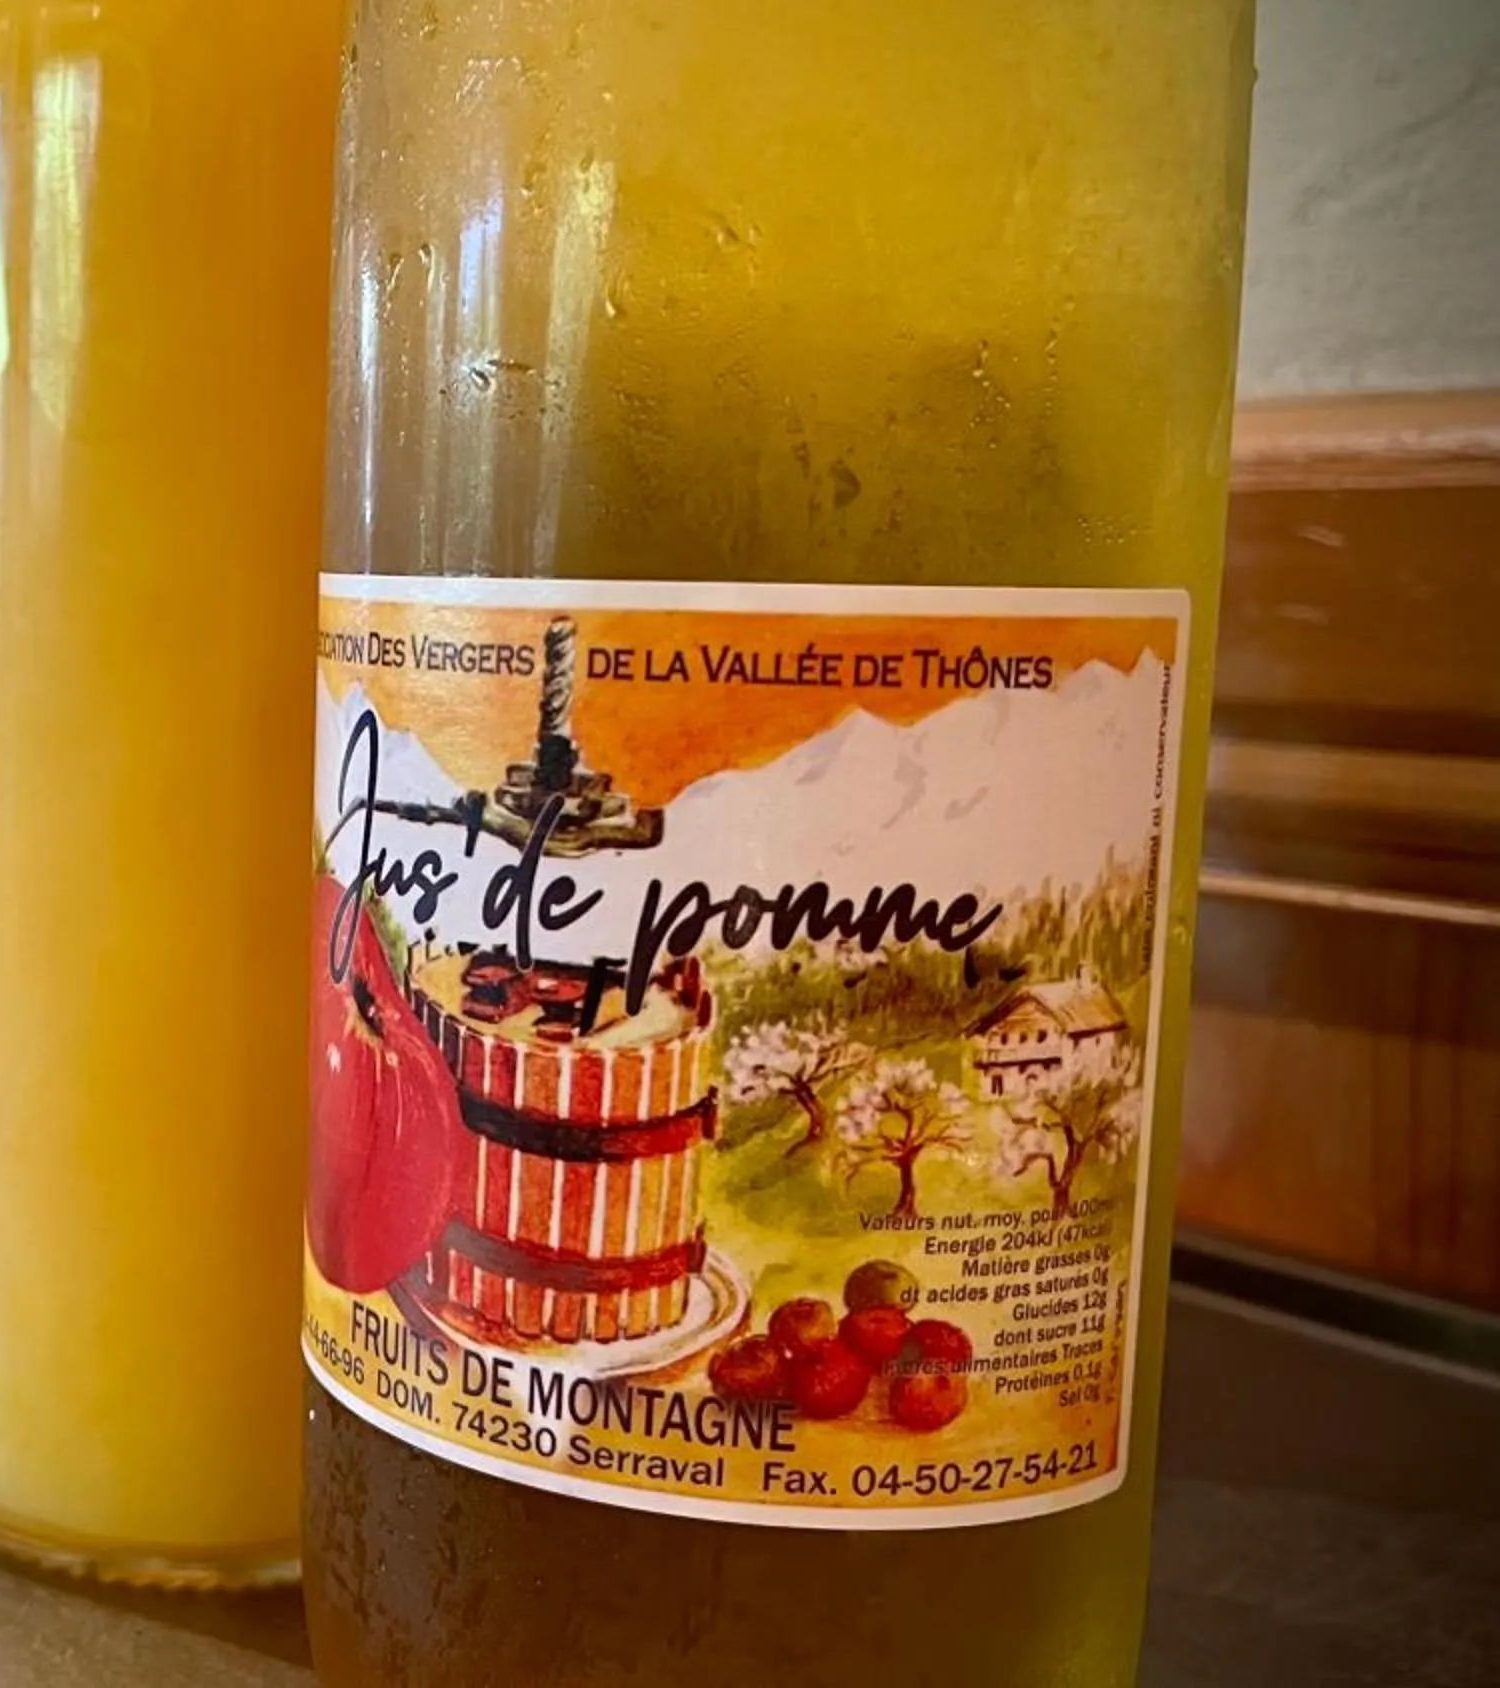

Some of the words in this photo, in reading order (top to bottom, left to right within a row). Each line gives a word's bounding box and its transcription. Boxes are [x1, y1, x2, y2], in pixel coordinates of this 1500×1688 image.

[410, 633, 536, 677] VERGERS
[587, 647, 635, 681] DE
[644, 649, 690, 683] LA
[699, 642, 842, 687] VALLÉE
[852, 654, 904, 688] DE
[912, 645, 1054, 690] THÔNES
[325, 709, 461, 985] Jus
[483, 794, 604, 973] de
[624, 877, 1004, 1017] pomme
[859, 1211, 935, 1231] Valeurs
[940, 1212, 978, 1230] nut.
[983, 1210, 1026, 1230] moy.
[924, 1235, 997, 1257] Energie
[961, 1254, 1031, 1277] Matière
[1035, 1251, 1092, 1275] grasses
[926, 1283, 989, 1303] acides
[992, 1281, 1031, 1304] gras
[1012, 1297, 1079, 1321] Glucides
[993, 1327, 1032, 1347] dont
[1036, 1322, 1077, 1342] sucre
[350, 1299, 449, 1386] FRUITS
[461, 1347, 514, 1408] DE
[527, 1366, 797, 1453] MONTAGNE
[995, 1370, 1070, 1395] Protéines
[1058, 1386, 1081, 1407] Sel
[376, 1369, 441, 1425] DOM.
[451, 1401, 557, 1458] 74230
[567, 1439, 724, 1488] Serraval
[761, 1461, 838, 1496] Fax.
[851, 1439, 1098, 1497] 04-50-27-54-21
